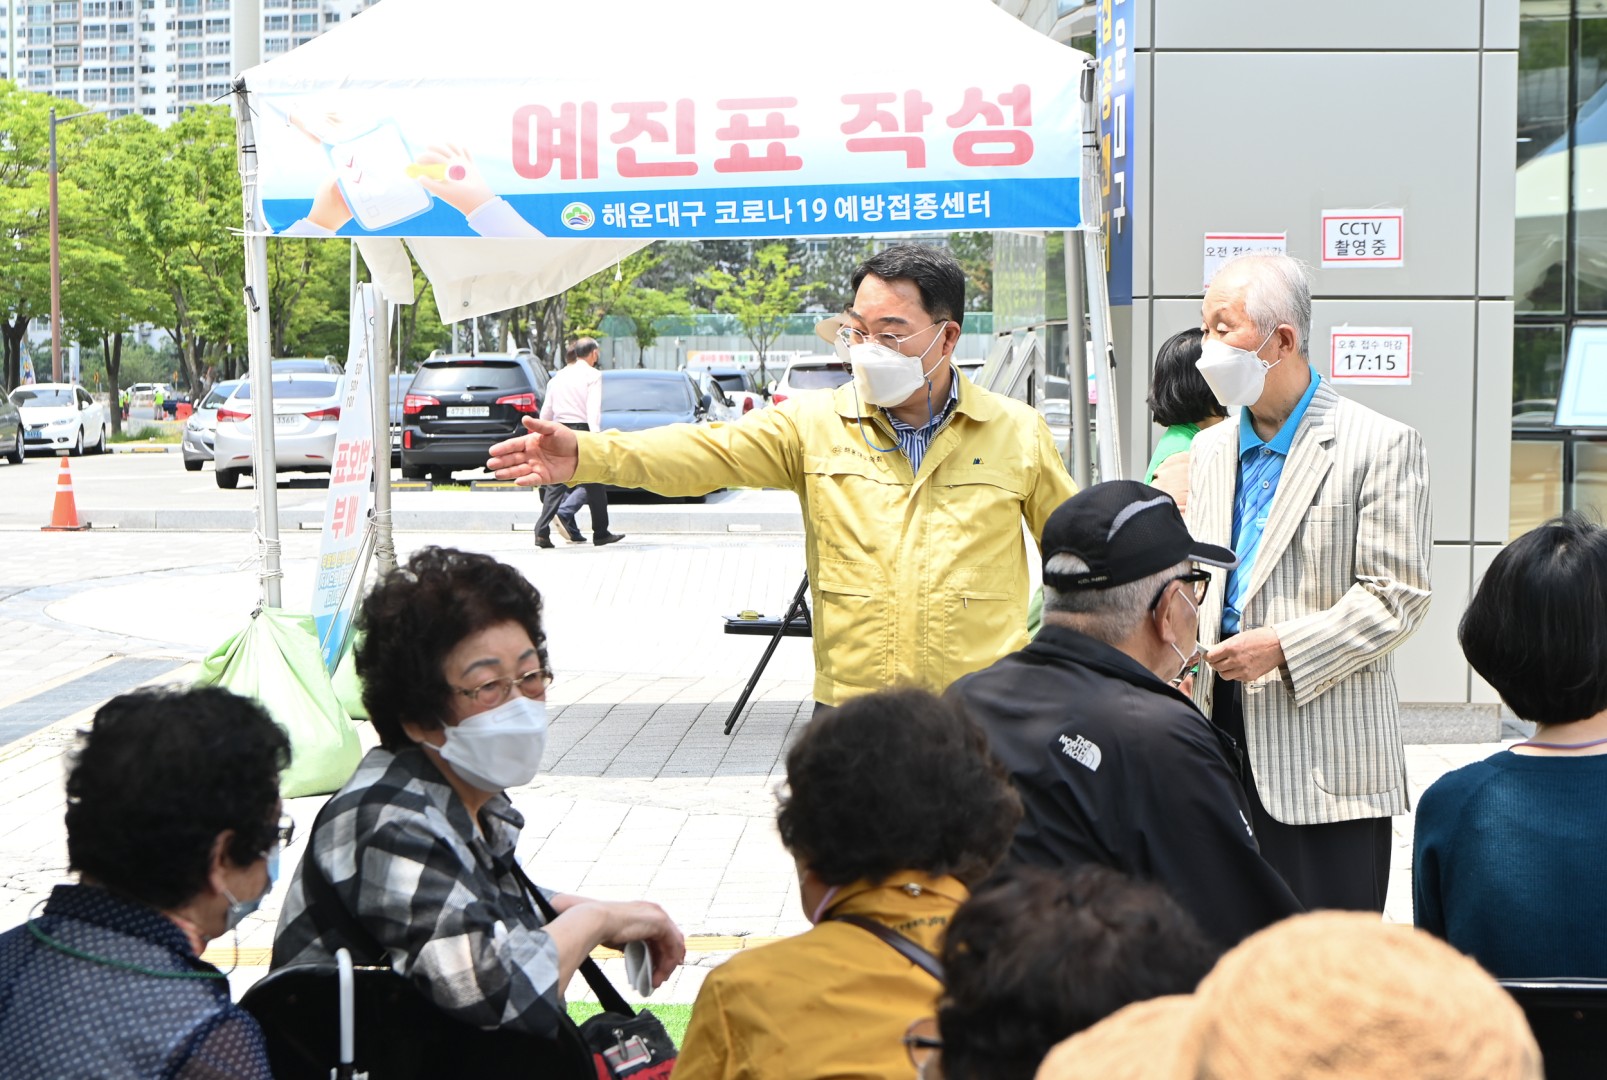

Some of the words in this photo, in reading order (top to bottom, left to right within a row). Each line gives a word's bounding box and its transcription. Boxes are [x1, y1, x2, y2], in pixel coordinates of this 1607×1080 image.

[1113, 0, 1127, 234] 운대구
[511, 96, 804, 181] 예진표
[839, 83, 1035, 169] 작성
[601, 200, 707, 229] 해운대구
[714, 197, 828, 226] 코로나19
[833, 190, 991, 223] 예방접종센터
[1339, 221, 1382, 236] CCTV
[1205, 246, 1228, 258] 오전
[1334, 239, 1366, 257] 촬영
[1371, 239, 1387, 256] 중
[1337, 340, 1356, 350] 오후
[1361, 340, 1379, 350] 접수
[1383, 340, 1402, 351] 마감
[1344, 354, 1396, 371] 17:15
[1058, 733, 1089, 756] NORTH
[1076, 733, 1092, 748] THE
[1062, 744, 1084, 762] FACE
